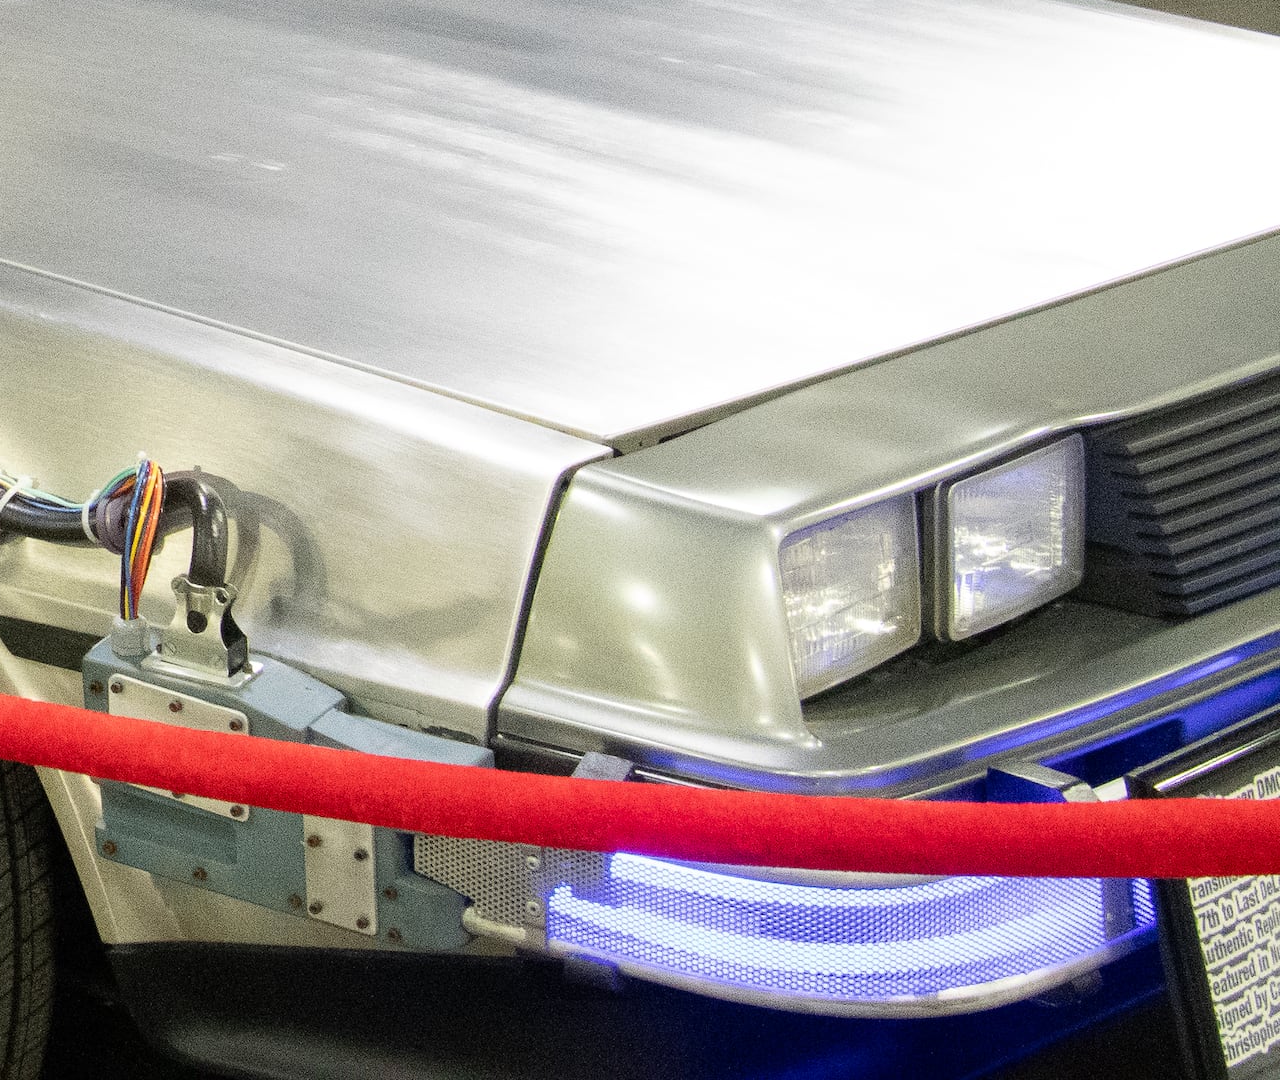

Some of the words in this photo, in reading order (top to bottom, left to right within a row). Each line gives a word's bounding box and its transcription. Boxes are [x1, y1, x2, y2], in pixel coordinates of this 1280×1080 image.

[1221, 903, 1234, 922] to
[1235, 886, 1260, 914] Last
[1259, 875, 1280, 900] DeL
[1204, 926, 1254, 966] uthentic
[1254, 907, 1280, 940] Repli
[1213, 958, 1256, 996] eatured
[1258, 953, 1270, 972] in
[1219, 995, 1253, 1031] igned
[1253, 989, 1269, 1012] by
[1224, 1016, 1280, 1062] hristophe
